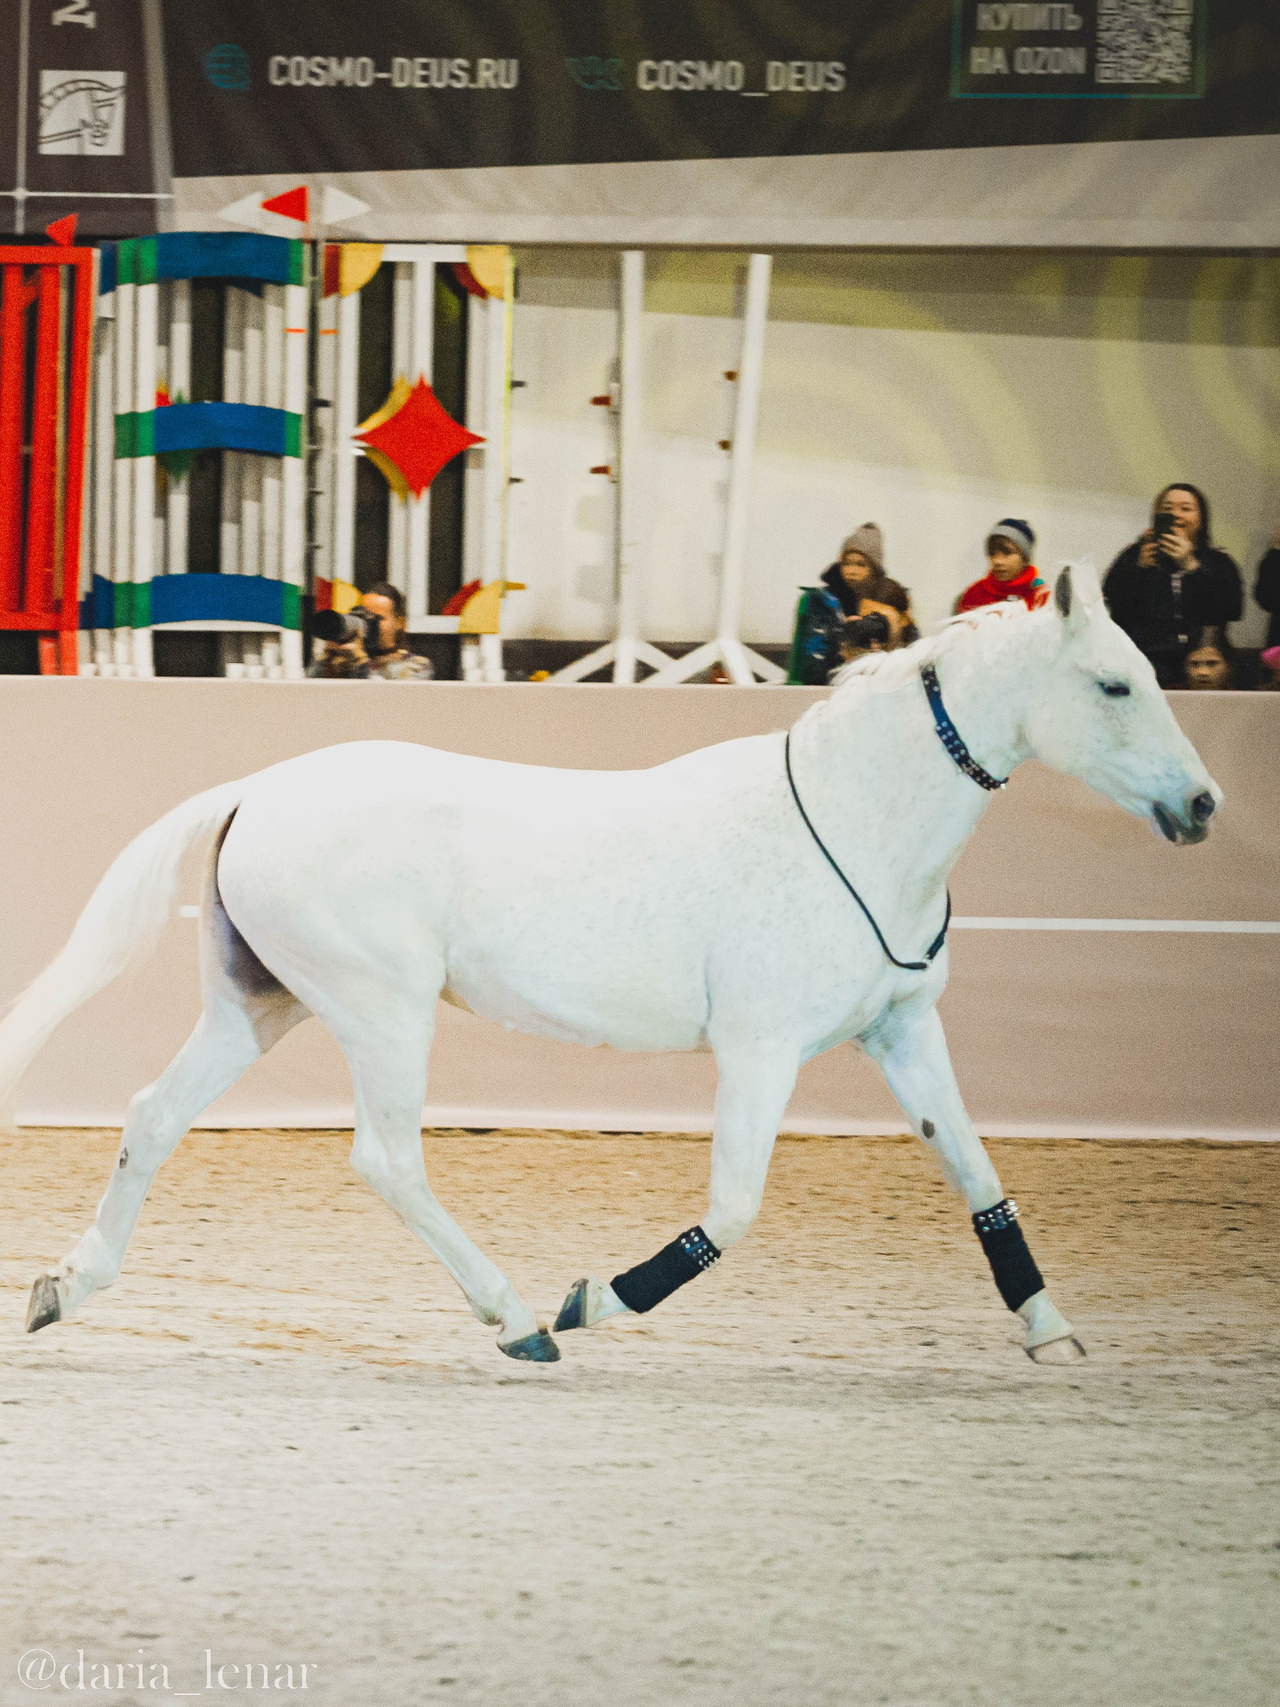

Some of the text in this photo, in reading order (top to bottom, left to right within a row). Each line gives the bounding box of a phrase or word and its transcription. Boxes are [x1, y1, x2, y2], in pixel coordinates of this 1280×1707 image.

[976, 3, 1083, 31] КУПИТЬ
[269, 55, 519, 89] COSMO-DEUS.RU
[969, 46, 1087, 75] НА OZON
[637, 59, 847, 97] COSMO_DEUS
